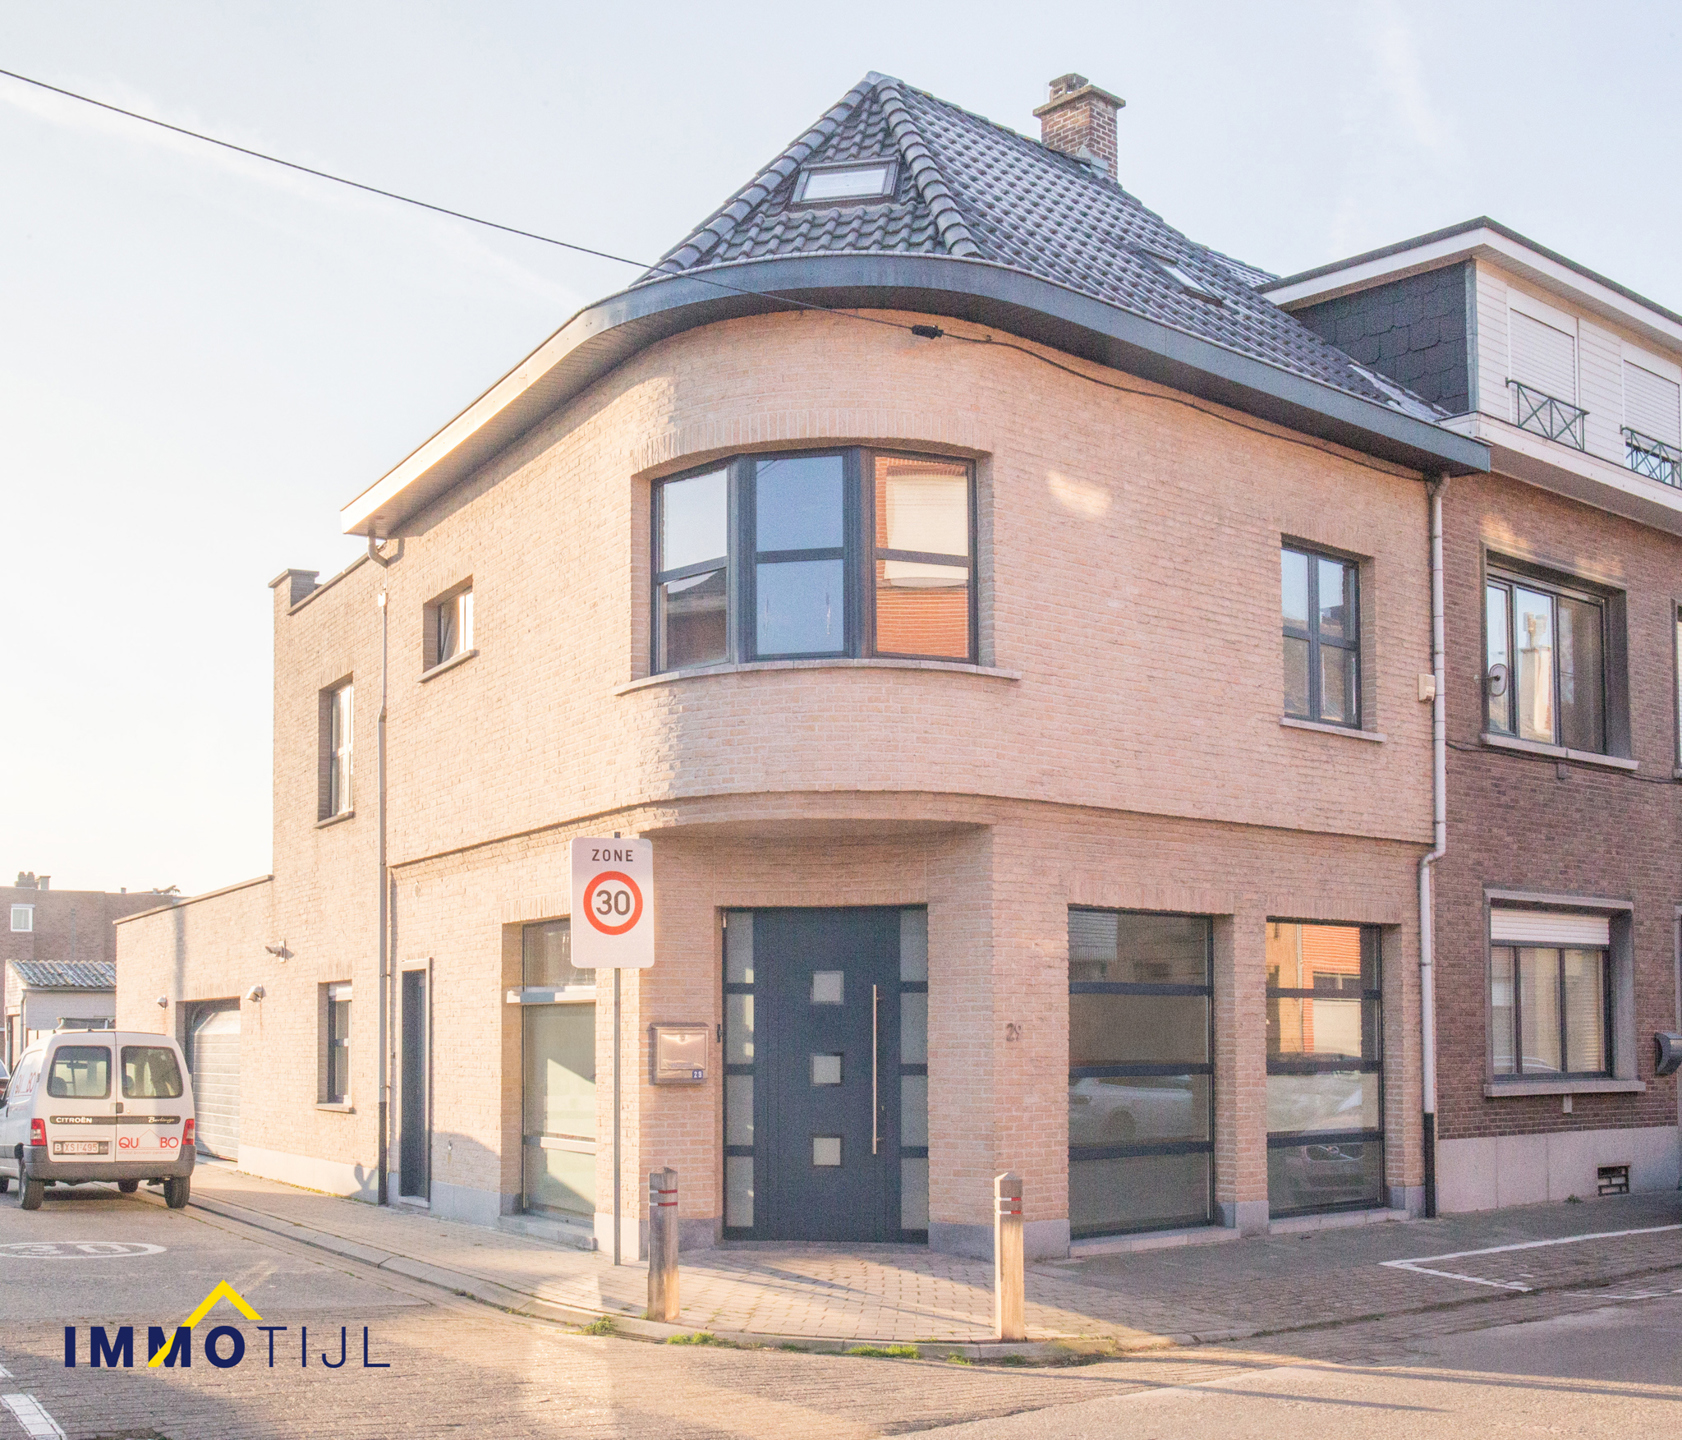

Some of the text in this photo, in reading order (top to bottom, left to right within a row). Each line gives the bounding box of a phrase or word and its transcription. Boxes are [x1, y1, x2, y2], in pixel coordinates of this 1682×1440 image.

[591, 848, 634, 862] ZONE
[595, 889, 631, 916] 30
[1006, 1022, 1022, 1042] 29
[55, 1116, 93, 1124] CITROËN
